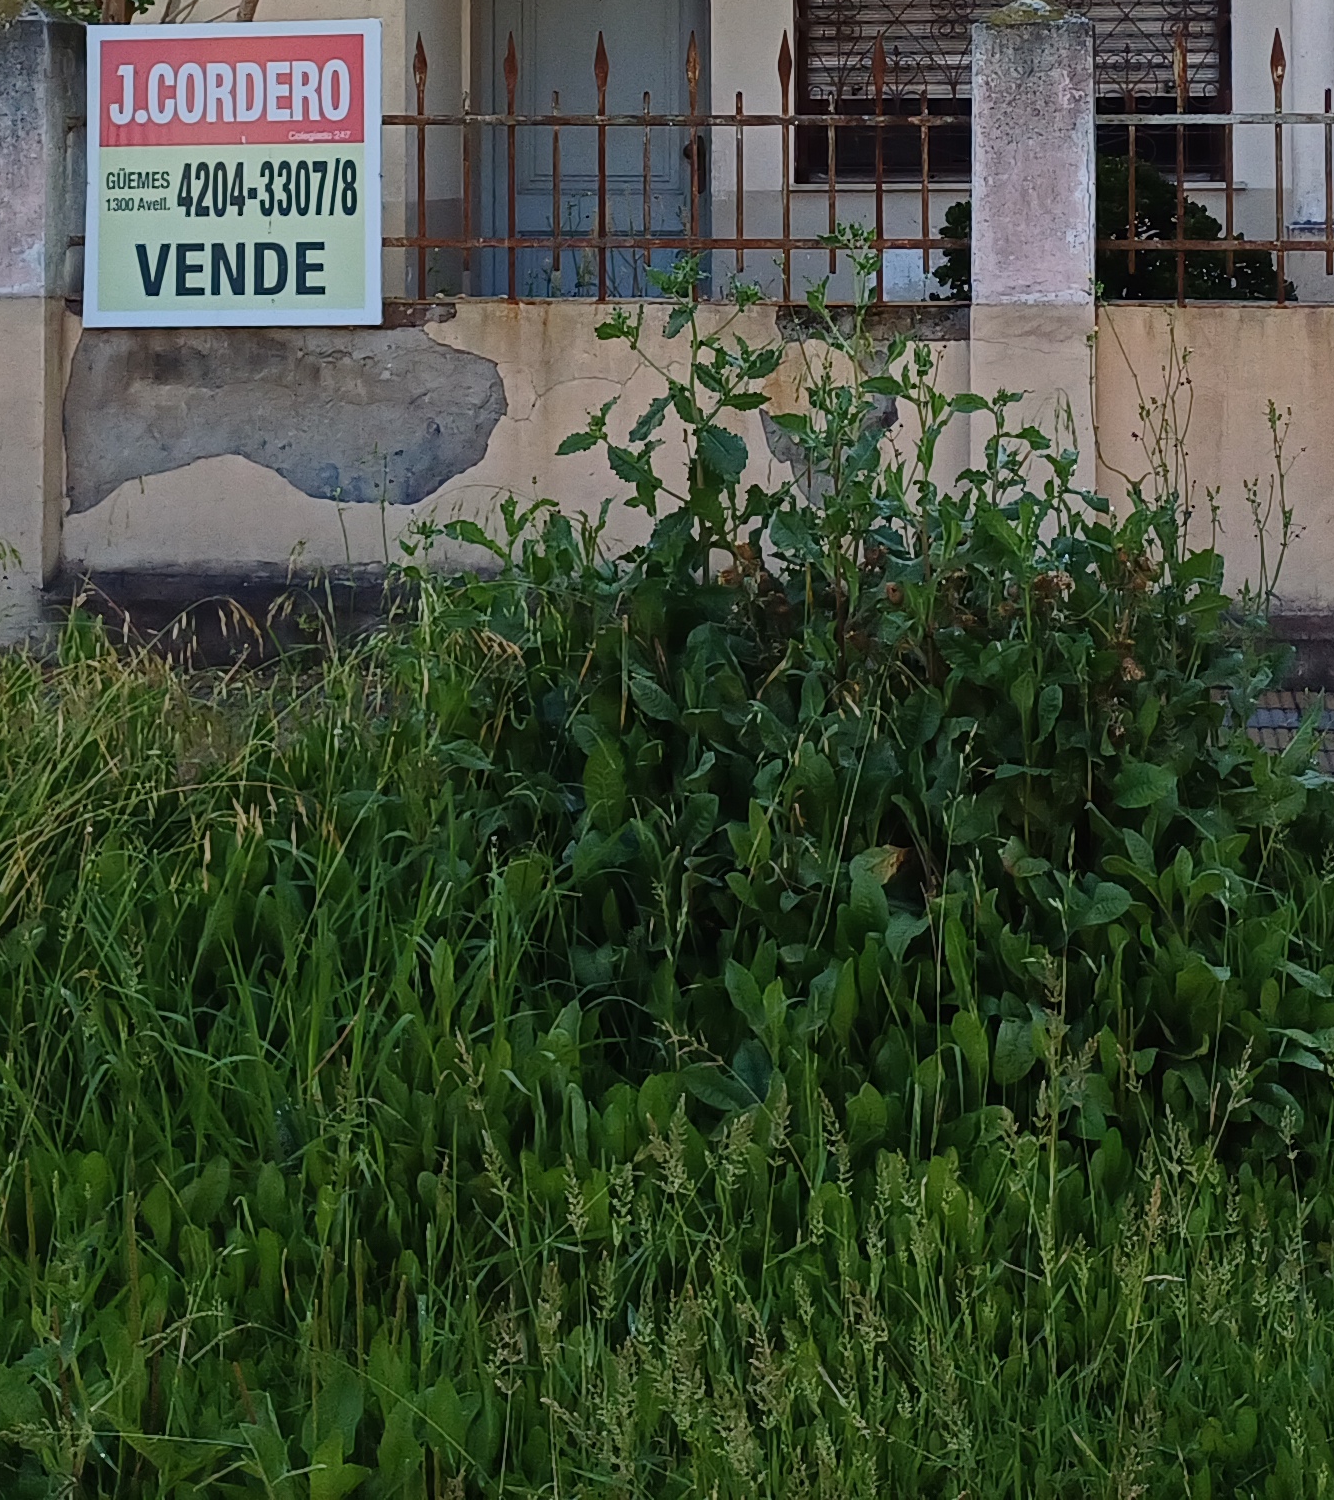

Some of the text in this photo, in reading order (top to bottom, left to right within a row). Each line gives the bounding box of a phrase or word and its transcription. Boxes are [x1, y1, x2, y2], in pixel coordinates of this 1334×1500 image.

[109, 59, 351, 125] J.CORDERO
[106, 167, 171, 190] GÜEMES
[106, 197, 135, 212] 1300
[177, 158, 358, 218] 4204-3307/8
[135, 241, 326, 297] VENDE
